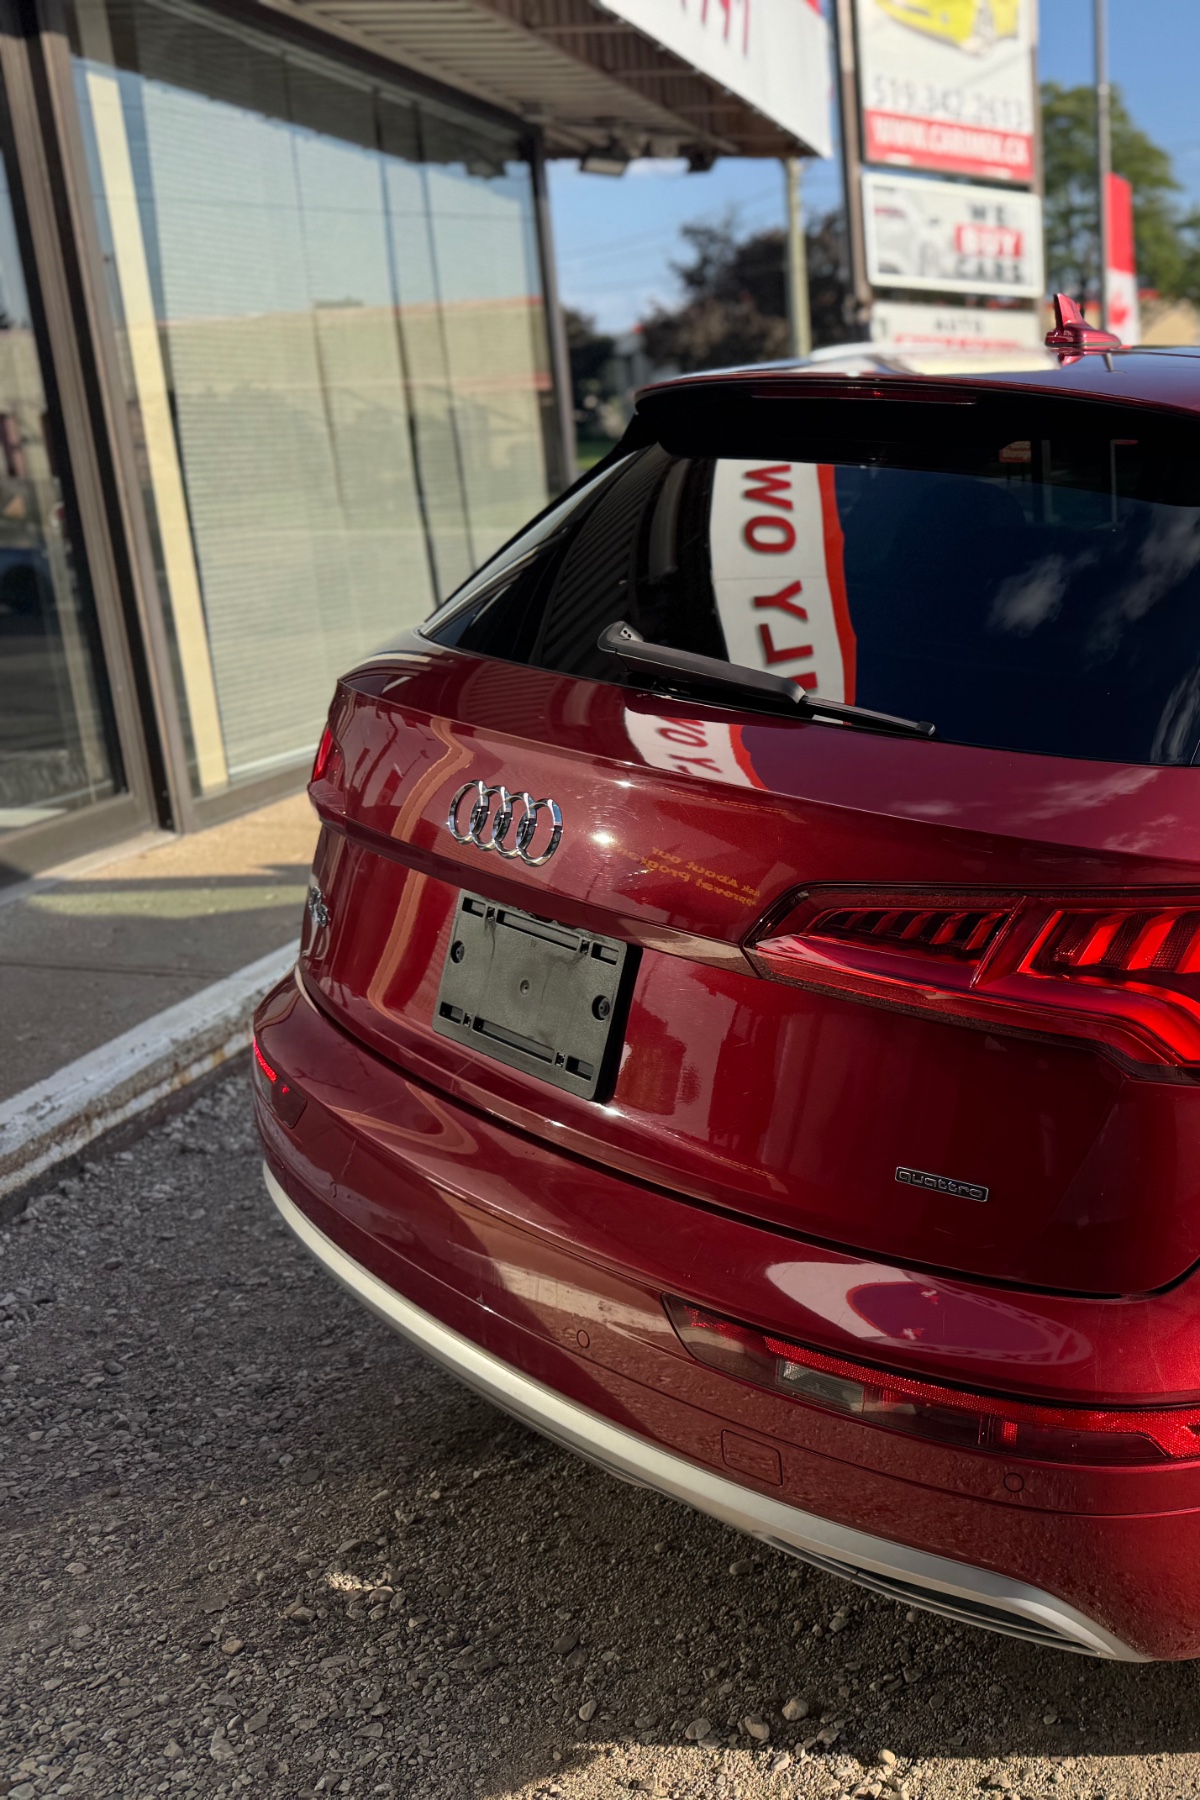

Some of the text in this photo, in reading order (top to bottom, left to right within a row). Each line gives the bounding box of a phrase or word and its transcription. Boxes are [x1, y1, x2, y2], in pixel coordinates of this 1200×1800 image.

[970, 203, 1006, 224] WE
[960, 227, 1019, 257] BUY
[955, 258, 1022, 284] CARS
[898, 1170, 983, 1198] quattro
